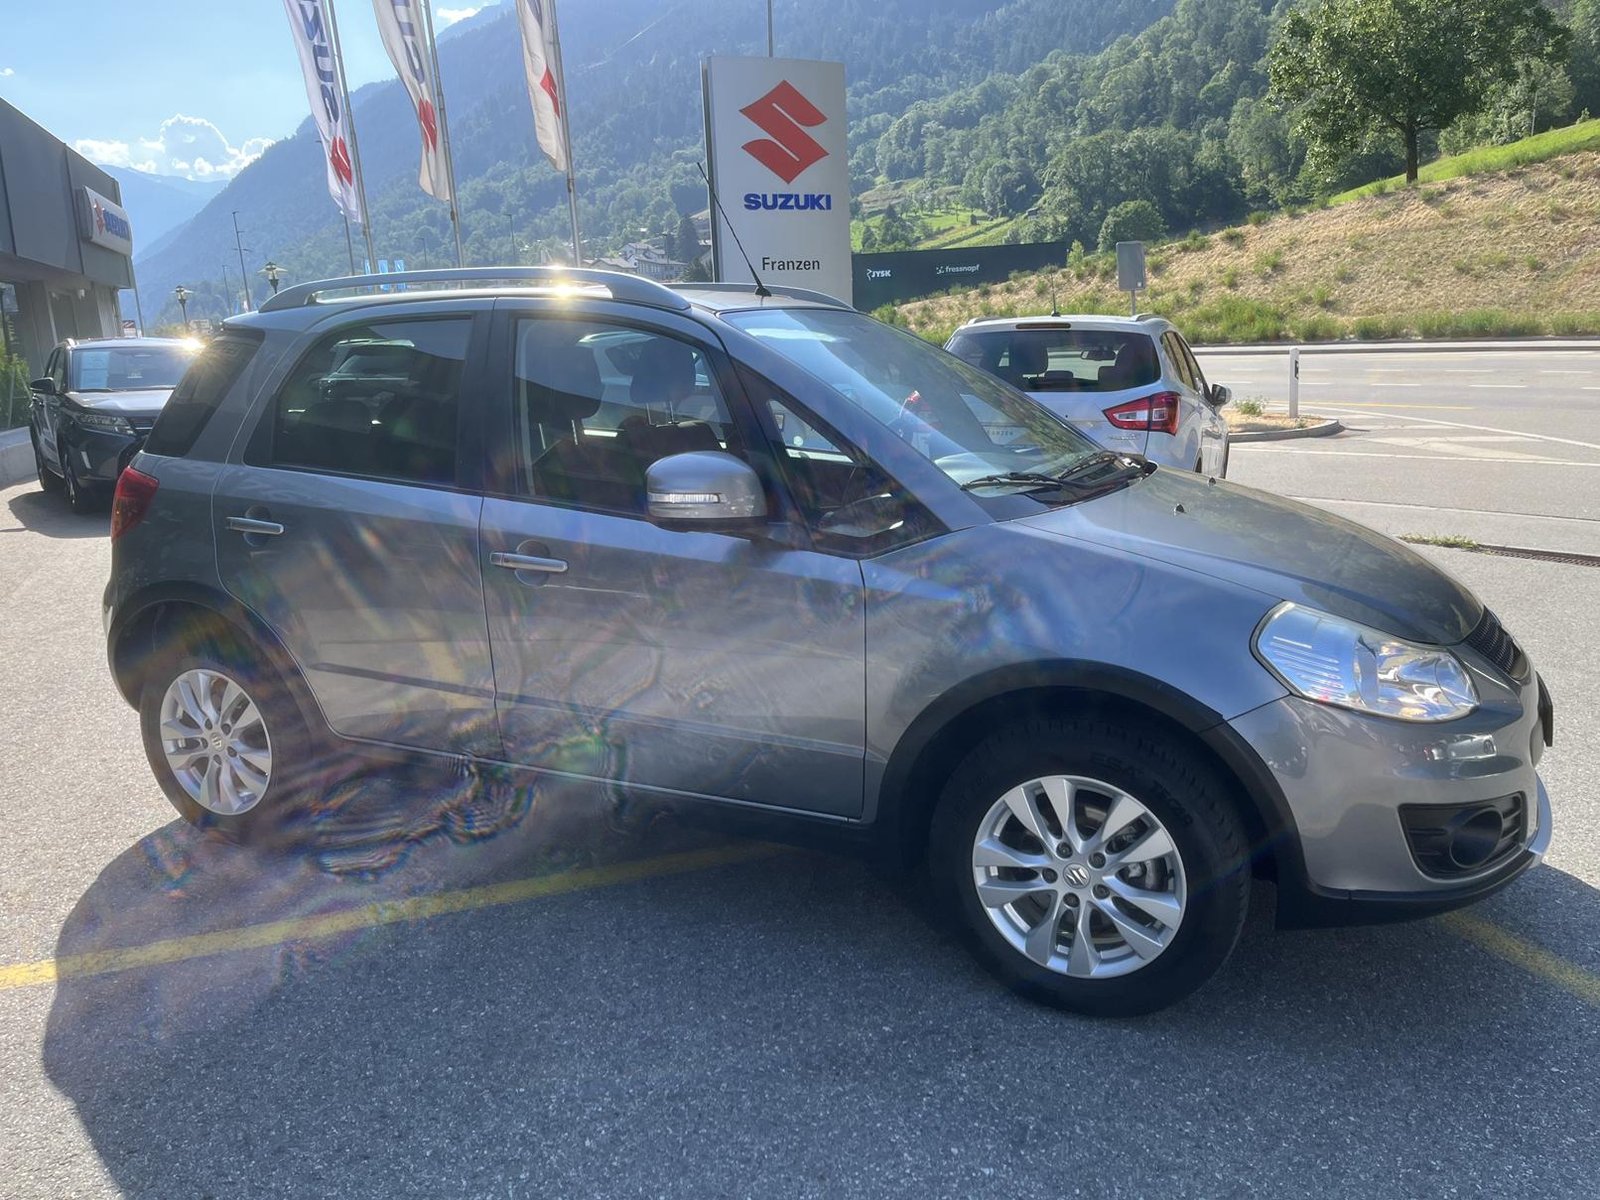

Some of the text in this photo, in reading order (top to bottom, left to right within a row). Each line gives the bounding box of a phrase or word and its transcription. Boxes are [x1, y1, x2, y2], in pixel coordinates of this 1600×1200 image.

[743, 193, 832, 211] SUZUKI
[762, 257, 820, 271] Franzen
[871, 270, 891, 278] JYSK
